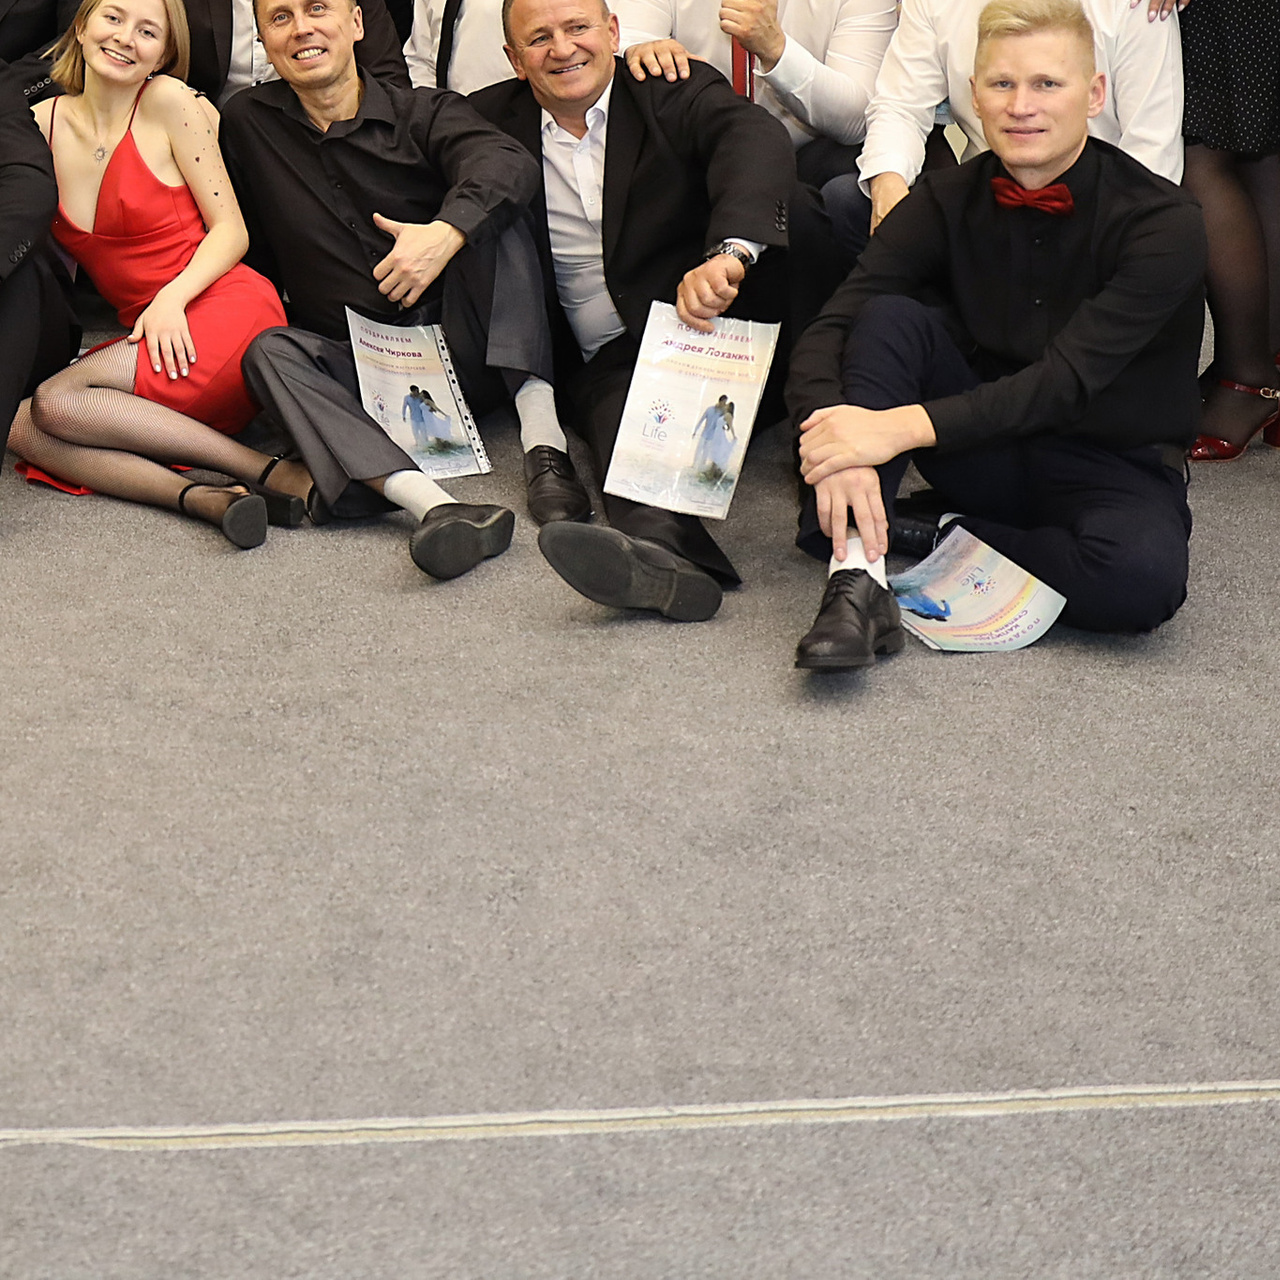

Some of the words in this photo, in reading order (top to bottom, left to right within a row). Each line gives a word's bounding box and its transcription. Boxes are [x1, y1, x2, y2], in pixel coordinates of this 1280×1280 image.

[677, 323, 754, 343] ПОДРАВЛЯЕМ
[359, 338, 384, 354] Алексея
[384, 347, 422, 358] Чиркова
[642, 422, 668, 442] Life
[960, 566, 984, 587] Life
